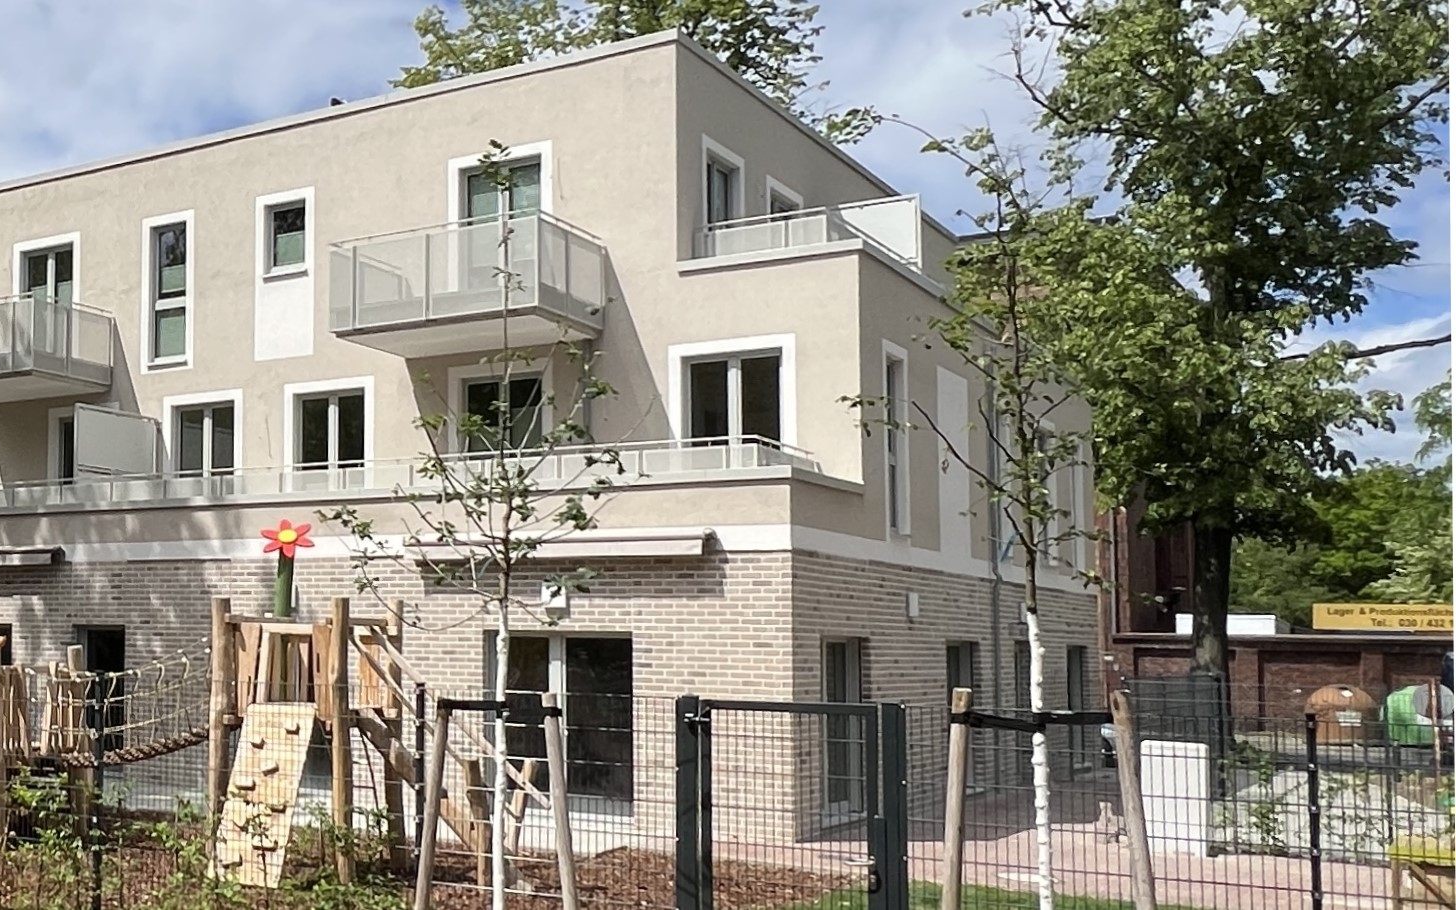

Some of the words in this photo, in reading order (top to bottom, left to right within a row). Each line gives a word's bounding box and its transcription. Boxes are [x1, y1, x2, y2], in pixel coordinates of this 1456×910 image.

[1327, 607, 1354, 617] Lager
[1359, 607, 1366, 615] &
[1399, 618, 1417, 627] 030
